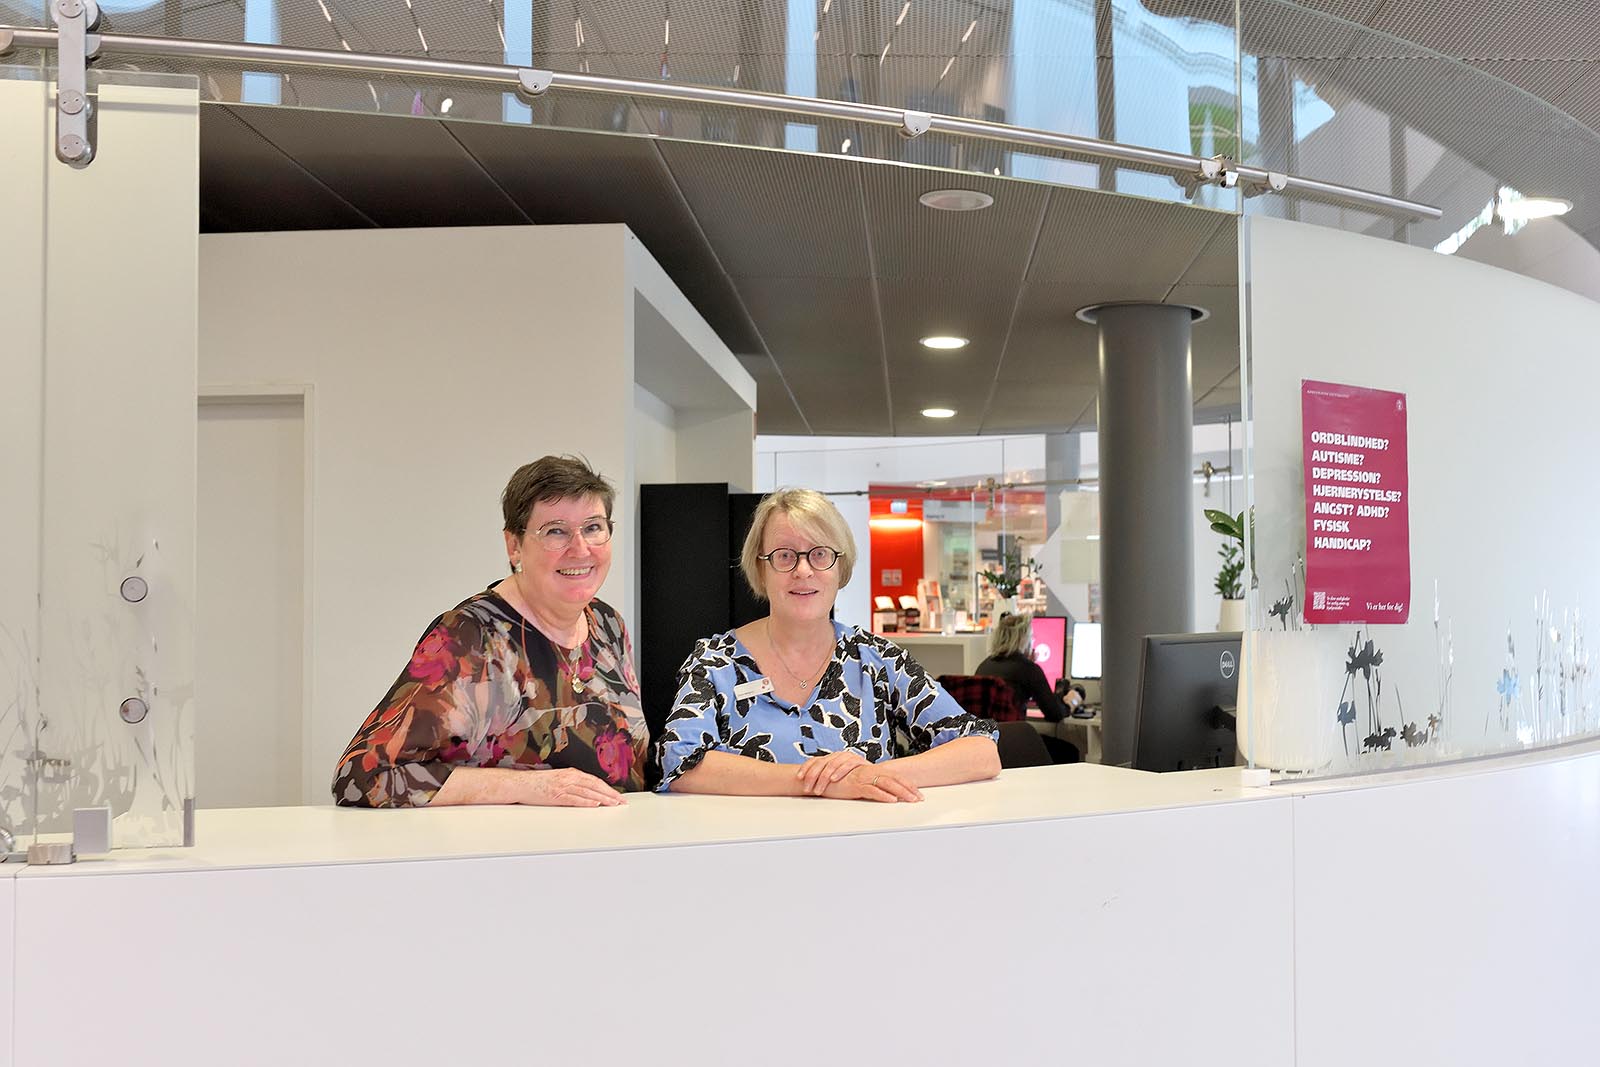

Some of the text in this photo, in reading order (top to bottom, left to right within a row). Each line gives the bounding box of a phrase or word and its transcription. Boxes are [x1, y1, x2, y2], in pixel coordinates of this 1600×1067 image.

[1311, 431, 1389, 450] ORDBLINDHED?
[1311, 450, 1365, 466] AUTISME?
[1312, 467, 1381, 484] DEPRESSION?
[1313, 484, 1402, 503] HJERNERYSTELSE?
[1313, 502, 1390, 518] ANGST? ADHD?
[1313, 519, 1350, 533] FYSISK
[1314, 536, 1372, 551] HANDICAP?
